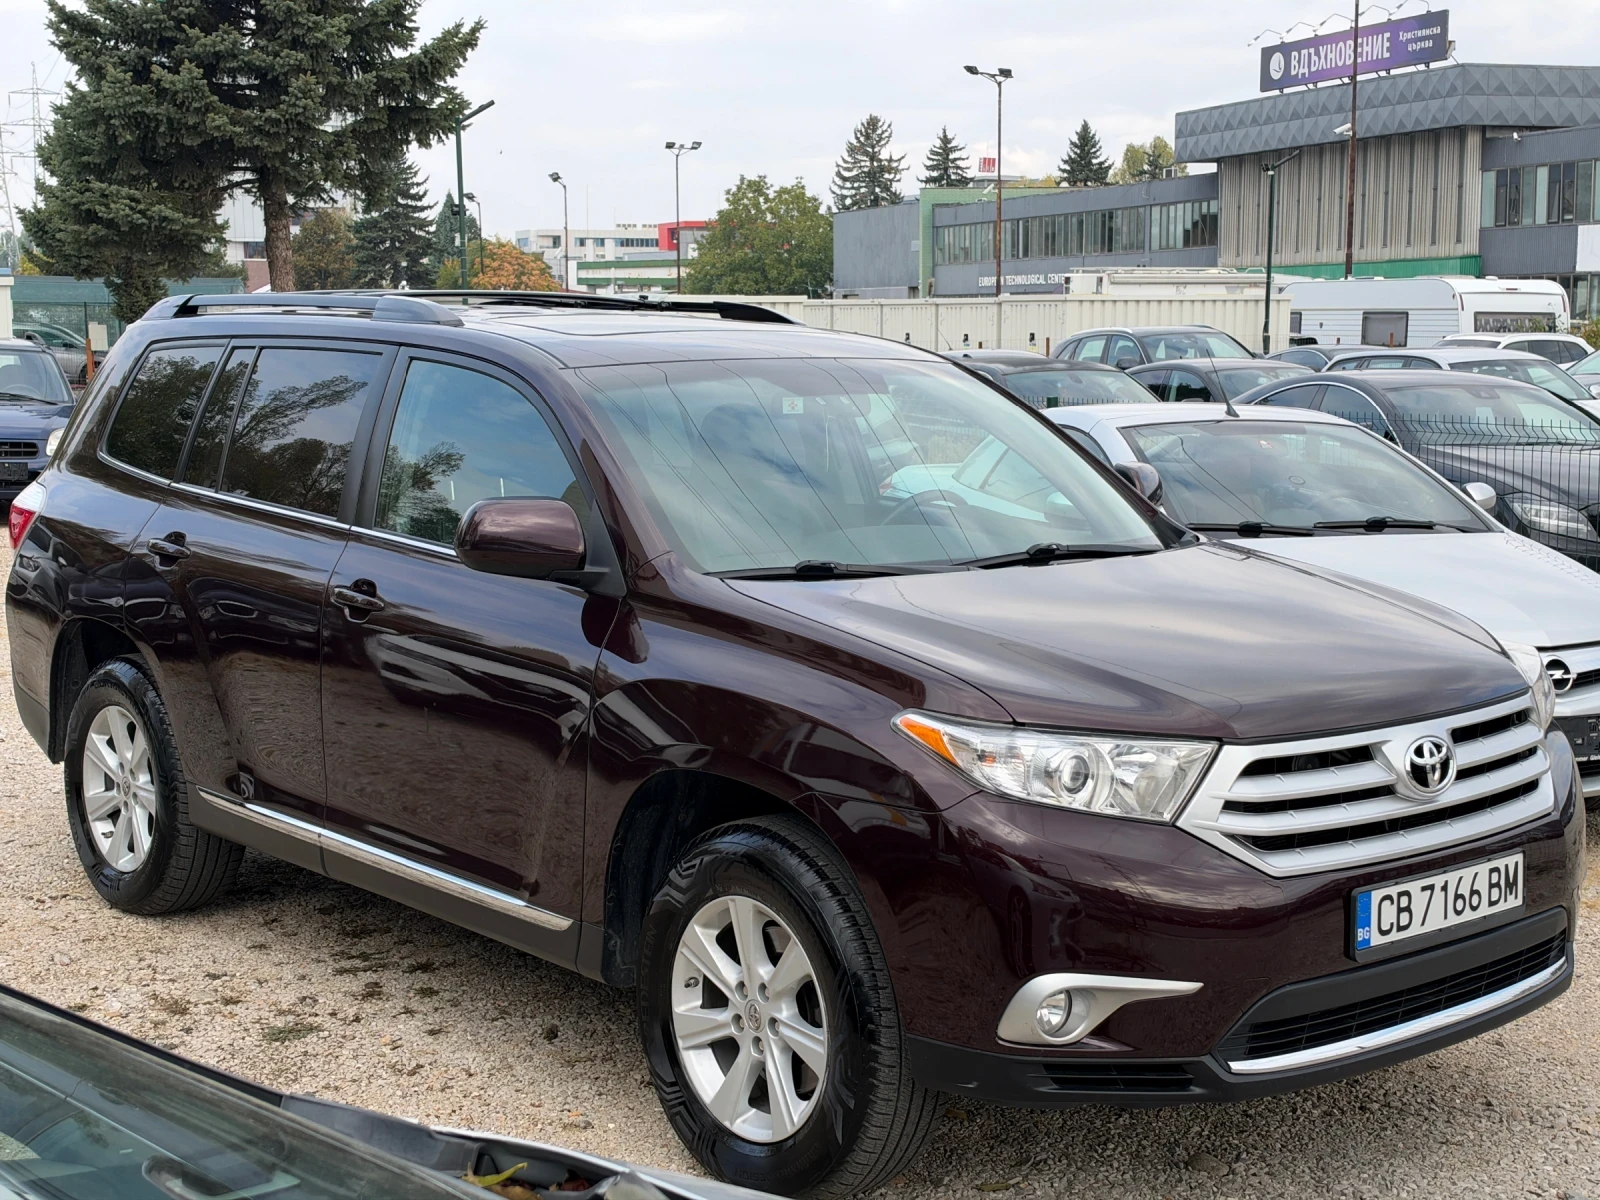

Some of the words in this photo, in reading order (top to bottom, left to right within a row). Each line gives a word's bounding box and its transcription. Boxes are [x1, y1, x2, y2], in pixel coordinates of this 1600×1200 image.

[1398, 26, 1441, 42] Християнска
[1407, 39, 1433, 52] църква
[1290, 32, 1391, 78] ВДЪХНОВЕНИЕ
[978, 276, 1004, 287] EUROPEN
[1005, 274, 1046, 286] TECHNOLOGICAL
[1047, 273, 1065, 285] CENTE
[1420, 871, 1482, 927] 7166
[1357, 926, 1370, 941] BG
